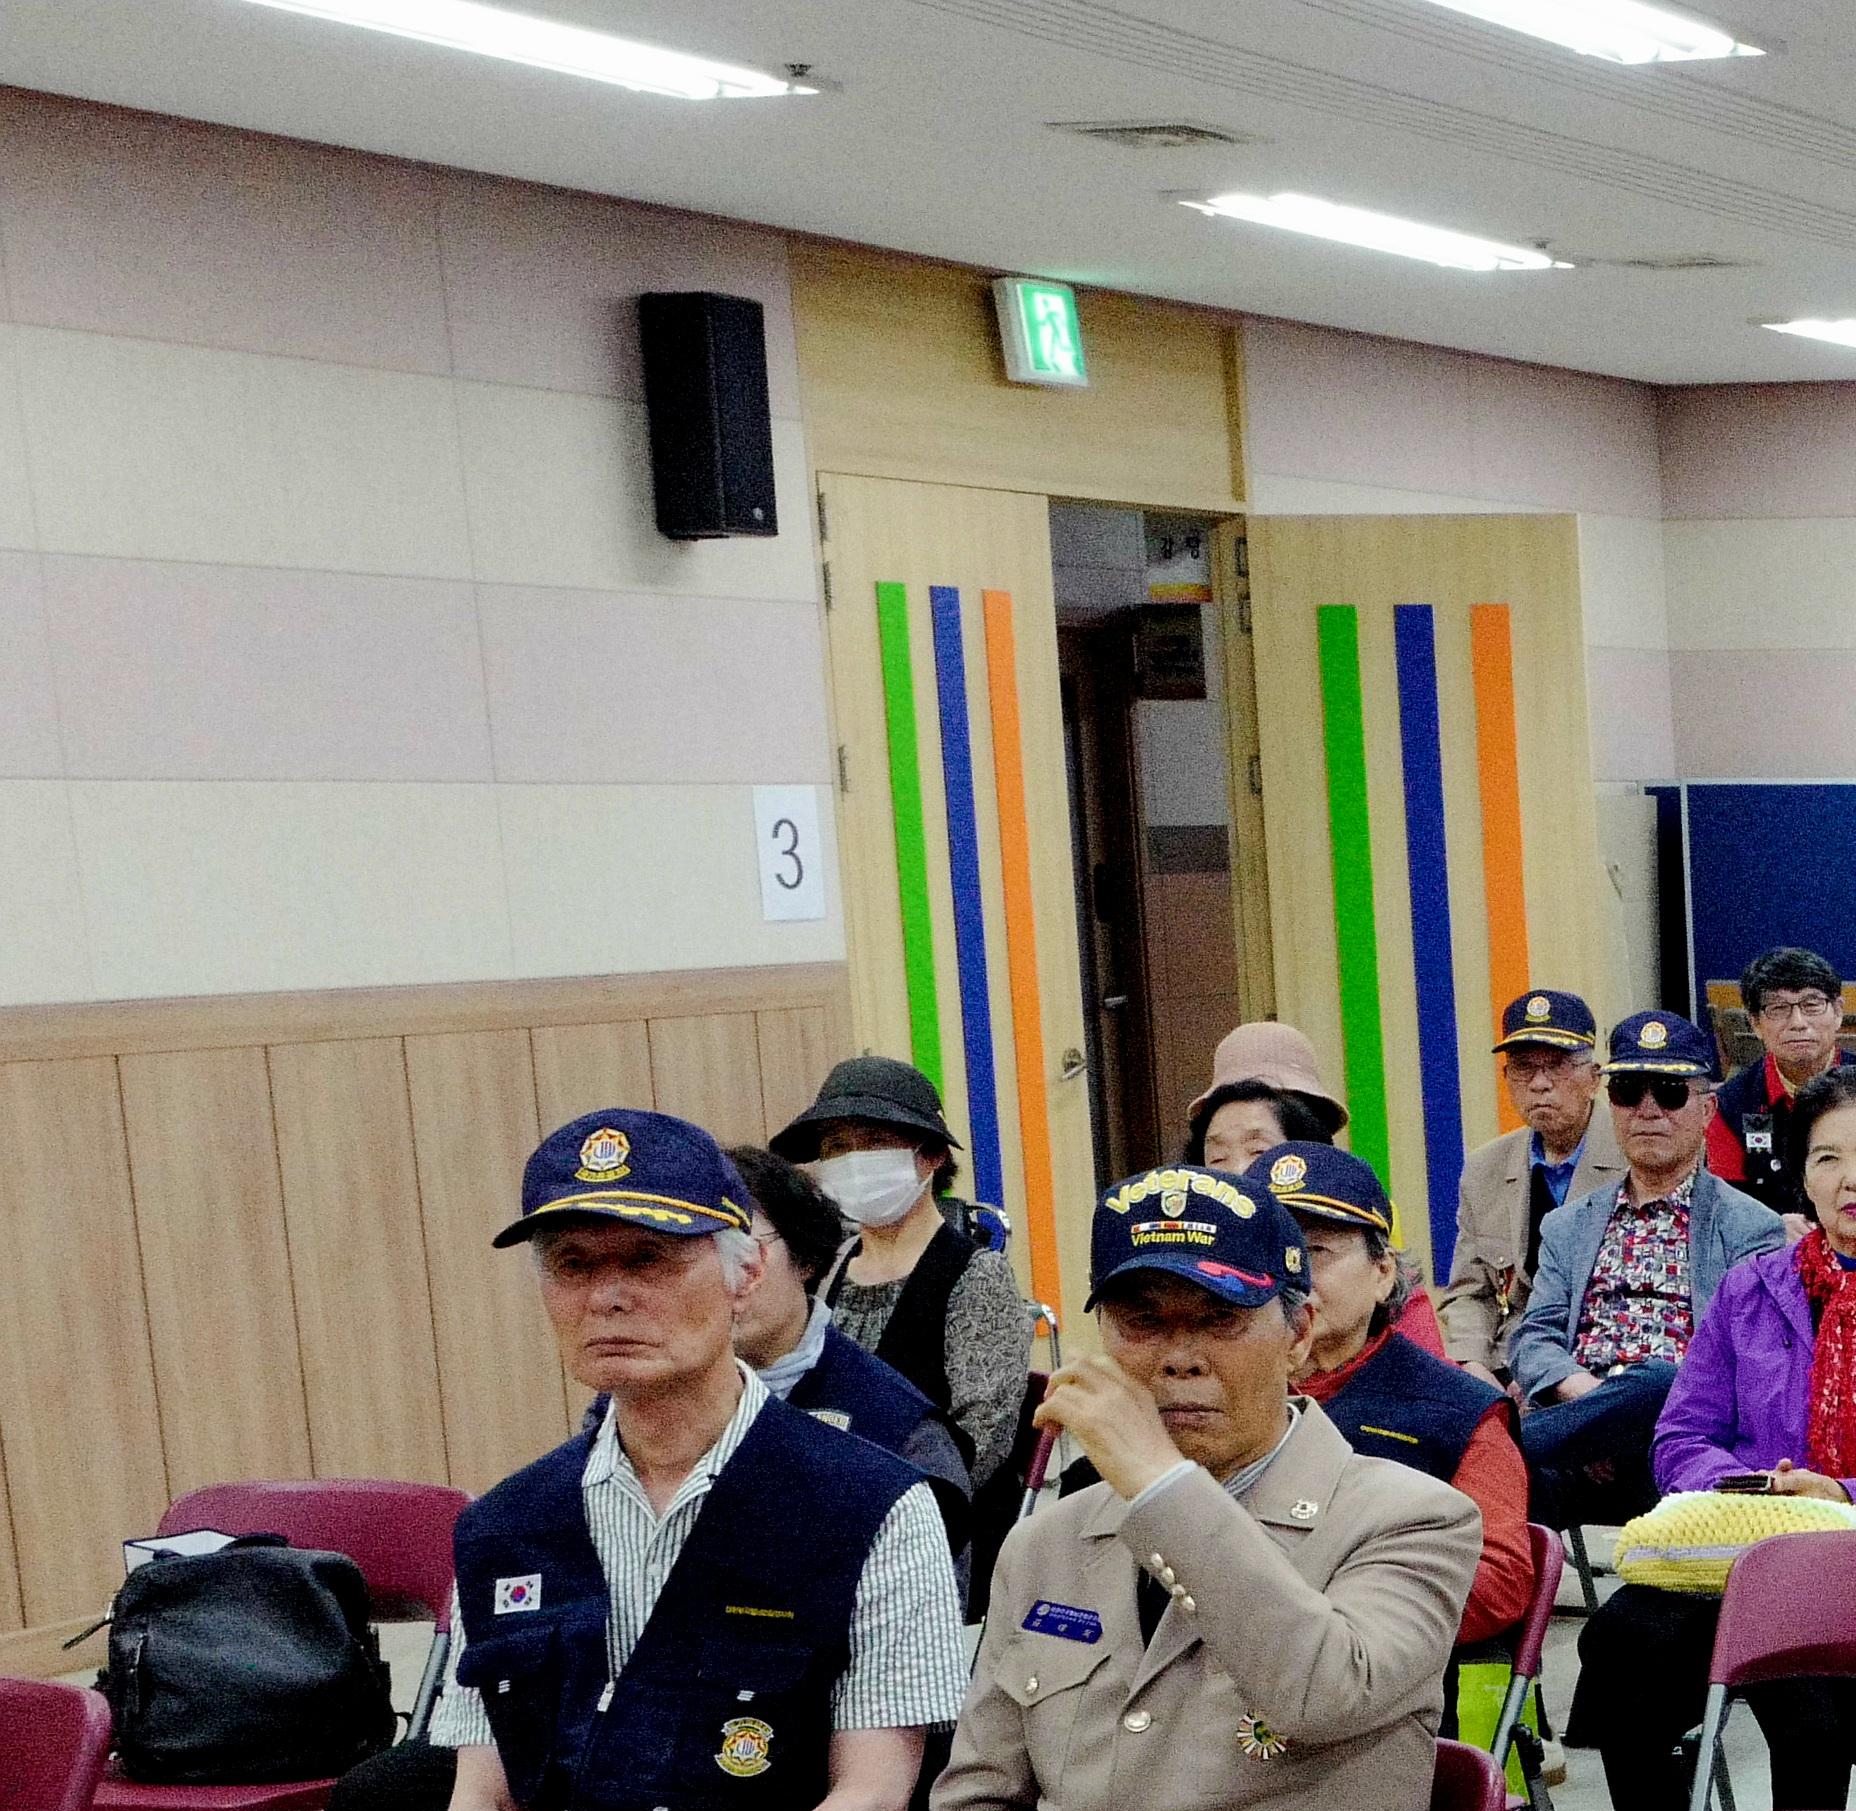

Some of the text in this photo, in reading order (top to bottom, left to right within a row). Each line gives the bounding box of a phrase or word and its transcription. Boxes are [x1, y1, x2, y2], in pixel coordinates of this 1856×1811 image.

[772, 818, 803, 890] 3
[1105, 1169, 1256, 1219] Veterans
[1131, 1230, 1215, 1247] Vietnam War
